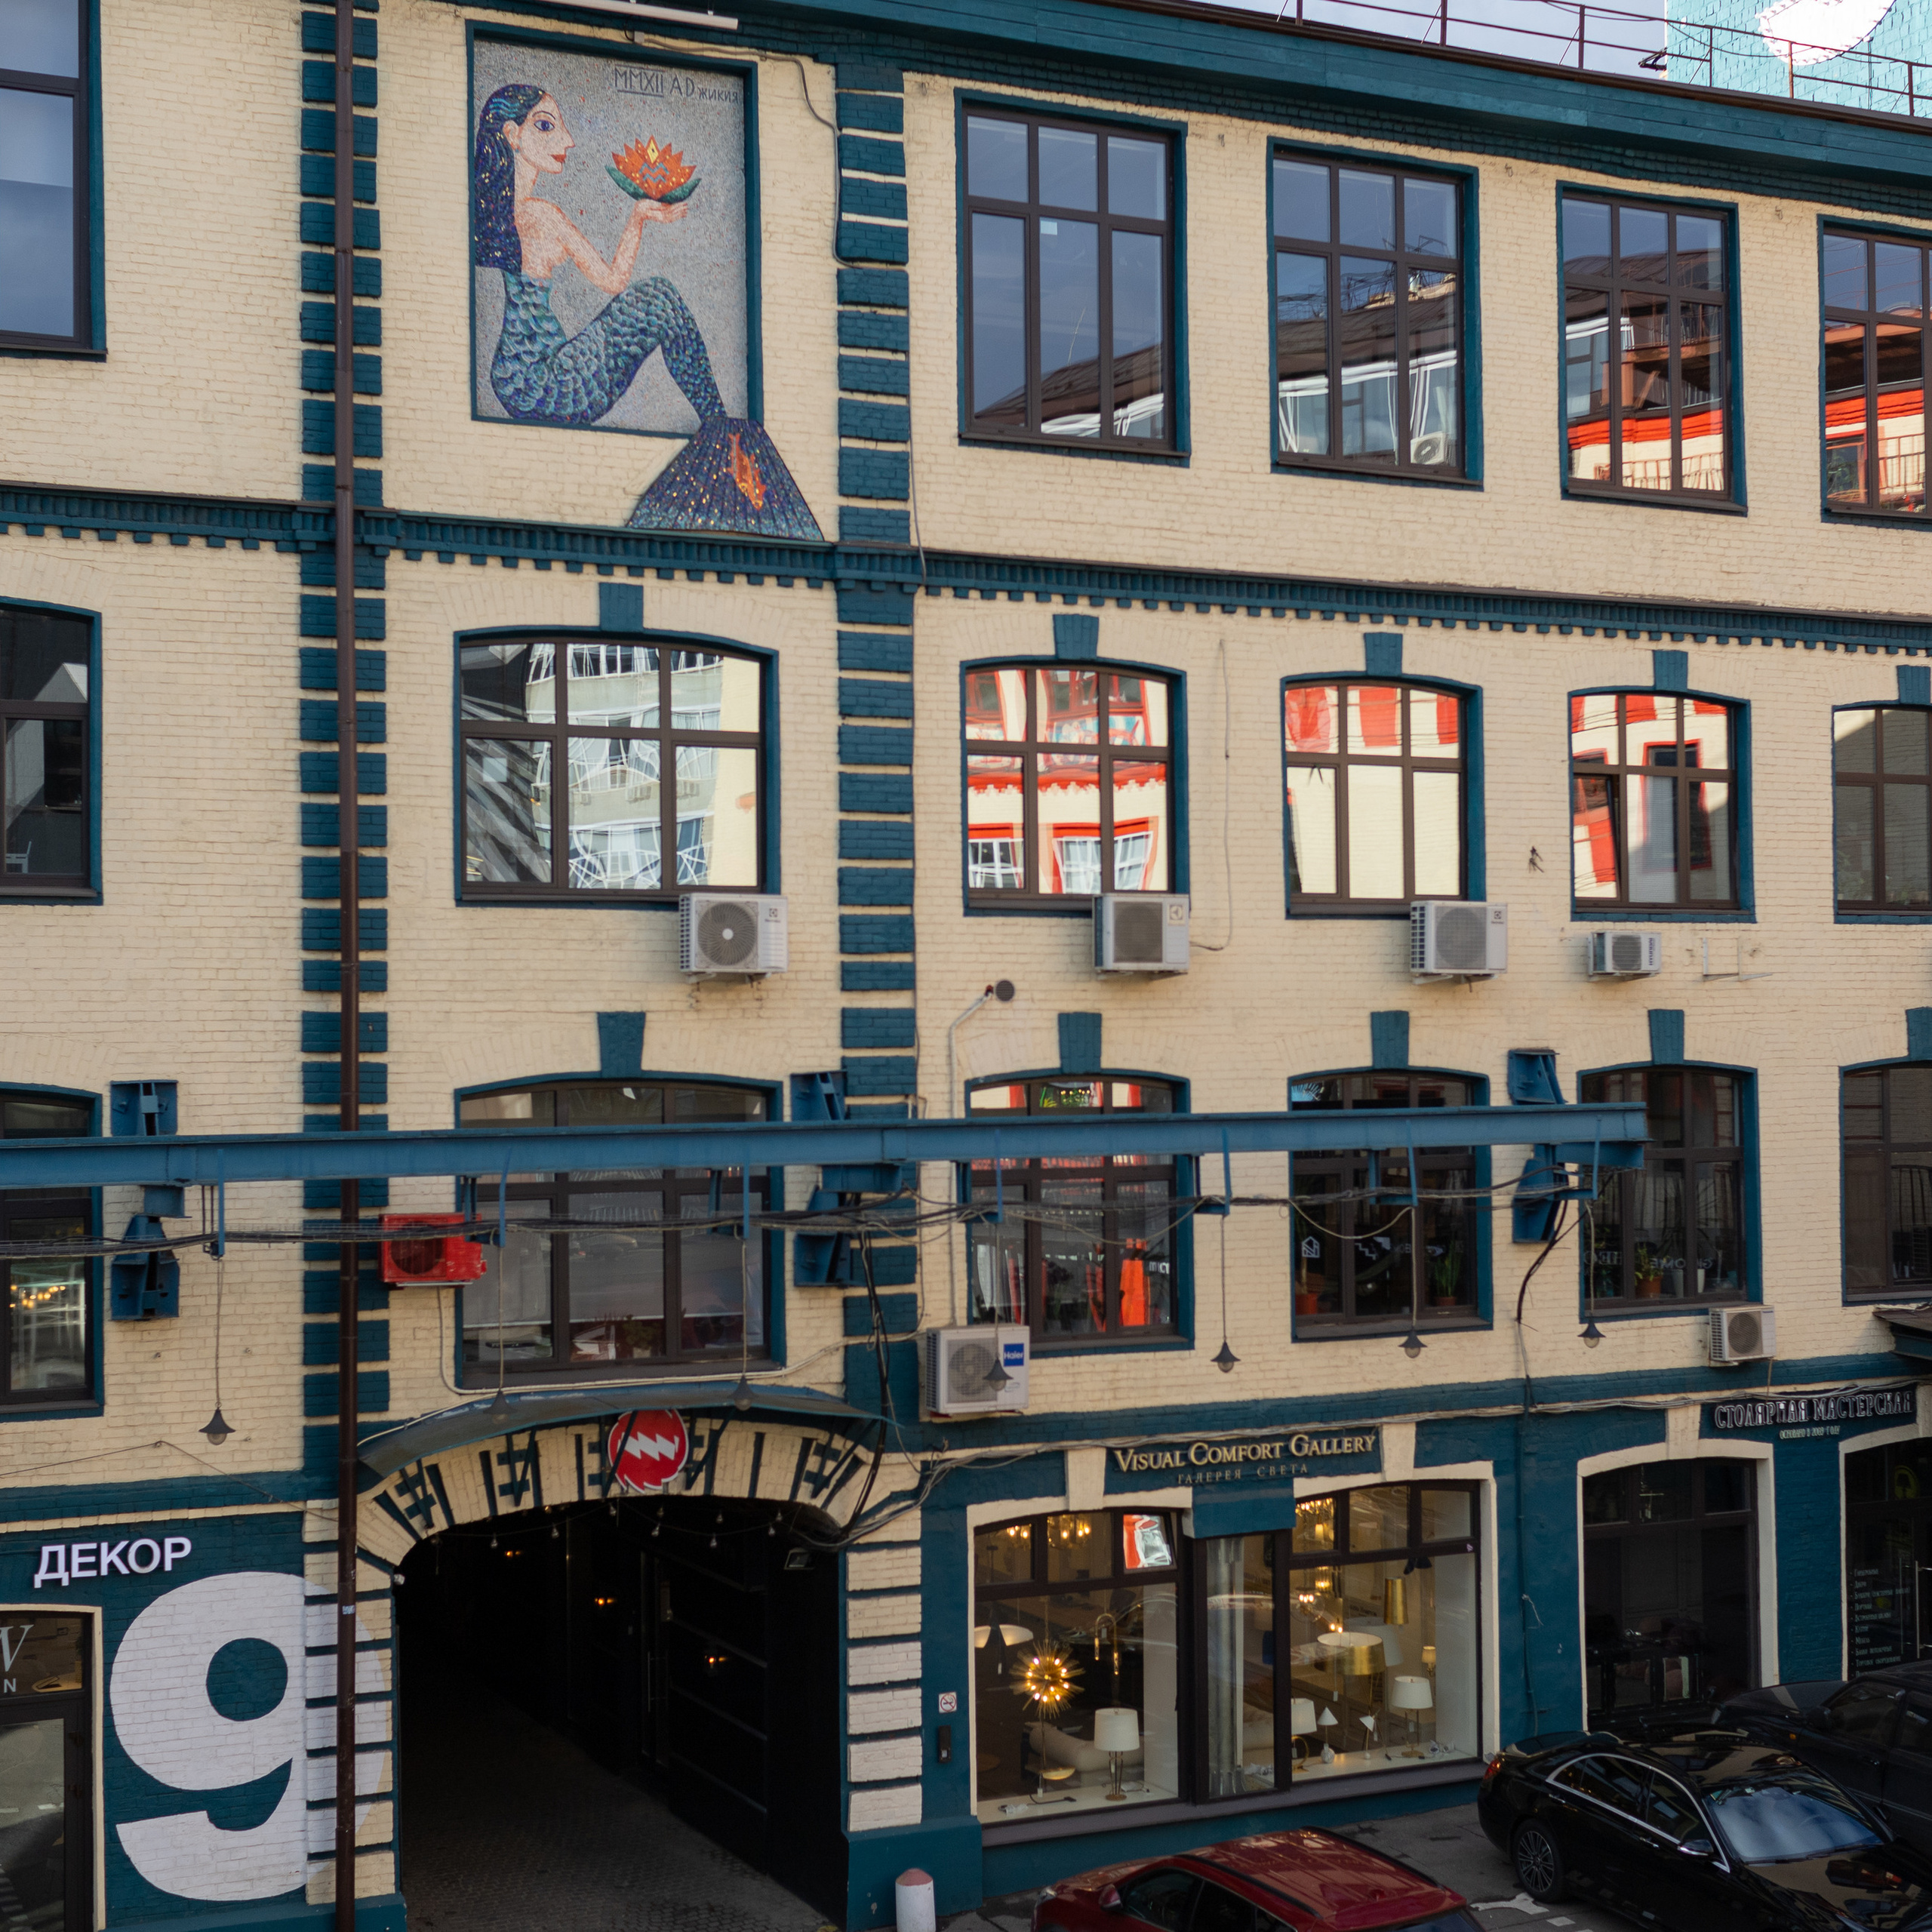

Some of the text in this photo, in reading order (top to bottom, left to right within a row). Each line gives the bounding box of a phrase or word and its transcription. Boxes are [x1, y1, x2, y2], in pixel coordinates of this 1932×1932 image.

[614, 66, 664, 94] MMXII
[1715, 1391, 1913, 1429] СТОЛЯРНАЯ МАСТЕРСКАЯ
[1177, 1463, 1309, 1484] ГАЛЕРЕЯ СВЕТА
[34, 1537, 192, 1588] ДЕКОР
[109, 1571, 386, 1902] 9
